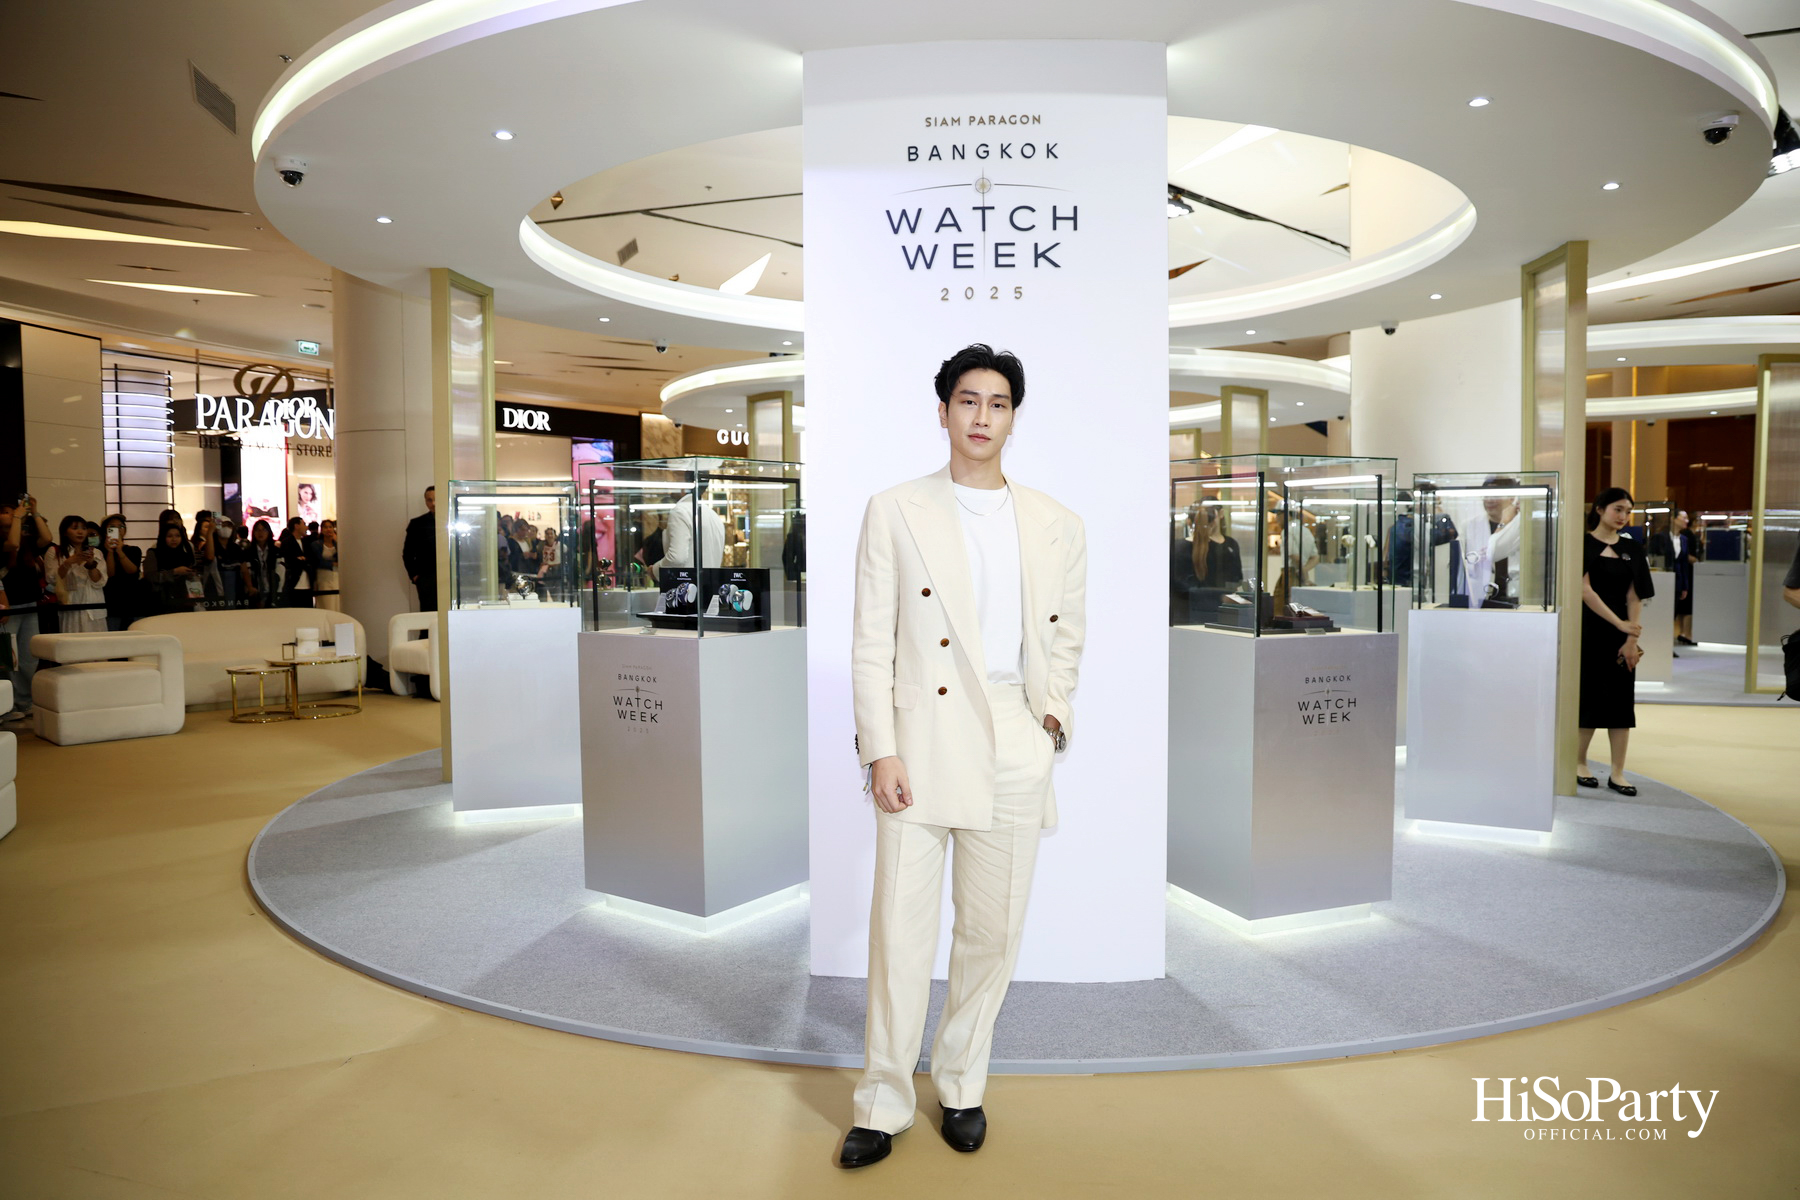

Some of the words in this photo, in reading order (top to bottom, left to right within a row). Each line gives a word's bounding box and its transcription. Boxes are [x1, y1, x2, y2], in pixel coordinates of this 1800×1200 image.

[925, 117, 961, 127] SIAM
[969, 114, 1041, 126] PARAGON
[908, 143, 1059, 162] BANGKOK
[886, 205, 1078, 235] WATCH
[901, 242, 1061, 270] WEEK
[940, 286, 1023, 301] 2025
[194, 393, 334, 440] PARAGON
[502, 407, 551, 431] DIOR
[296, 442, 332, 458] STORE
[618, 673, 657, 683] BANGKOK
[1305, 675, 1351, 684] BANGKOK
[613, 696, 663, 710] WATCH
[1298, 698, 1357, 711] WATCH
[617, 709, 658, 723] WEEK
[1302, 711, 1351, 725] WEEK
